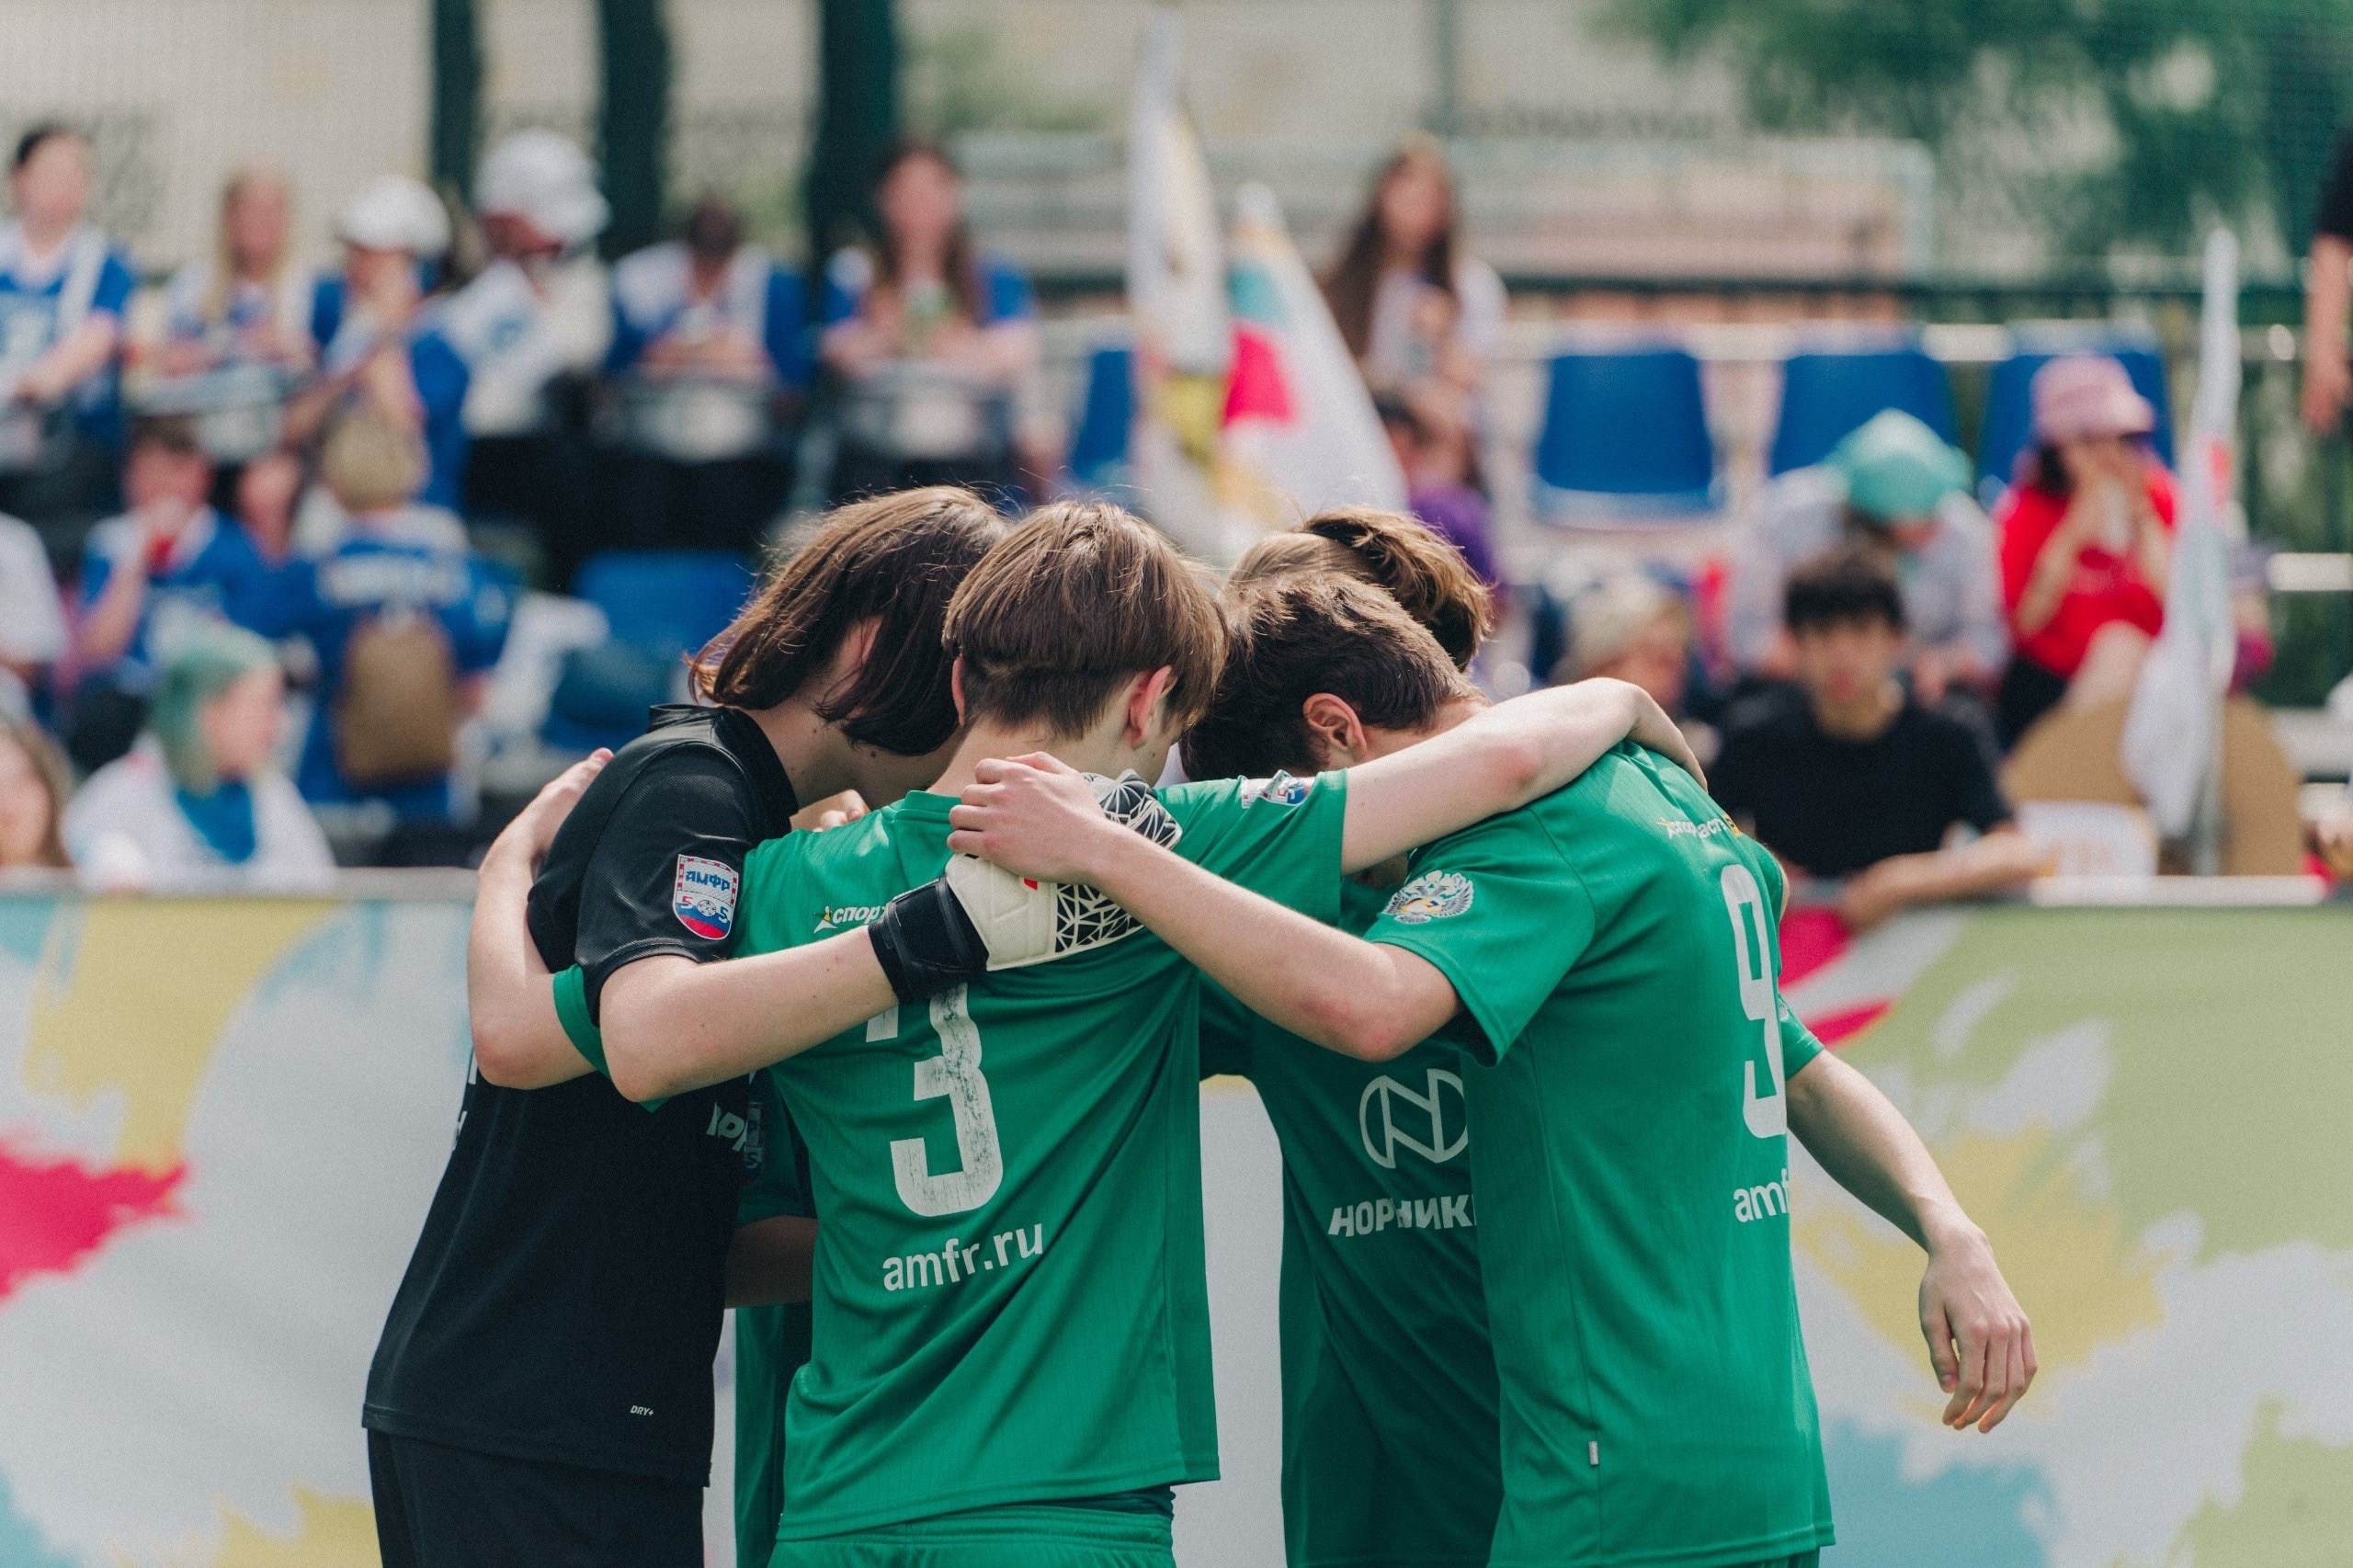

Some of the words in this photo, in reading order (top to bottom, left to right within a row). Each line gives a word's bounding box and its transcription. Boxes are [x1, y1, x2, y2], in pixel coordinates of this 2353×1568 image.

[685, 870, 731, 892] АМФР
[1720, 864, 1786, 1139] 9
[865, 982, 1004, 1217] 3
[882, 1223, 1044, 1291] amfr.ru
[630, 1404, 654, 1416] DRY+
